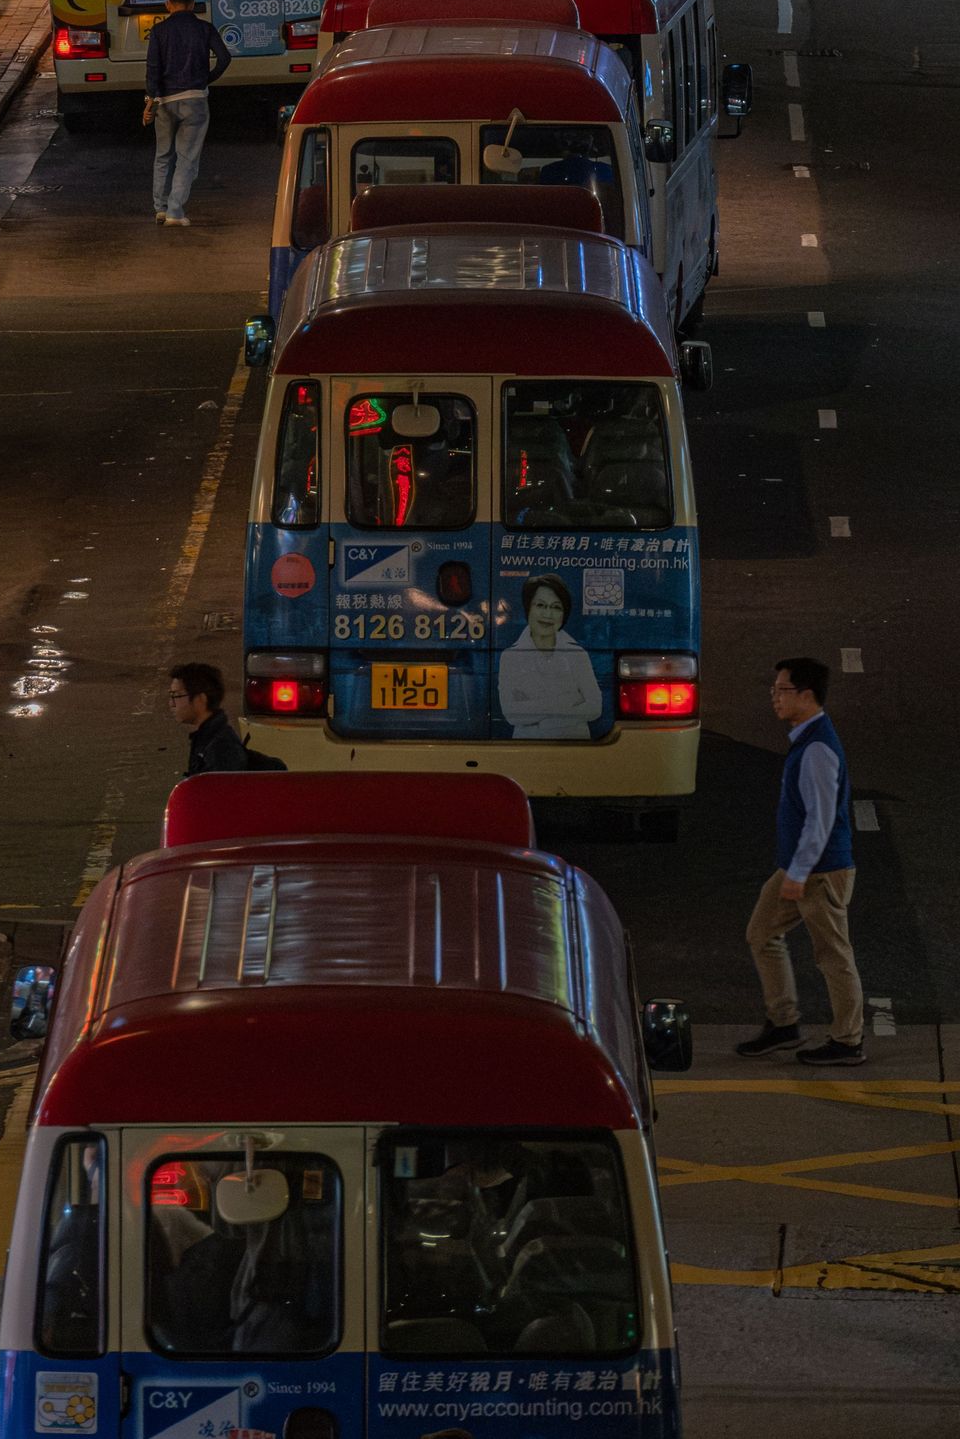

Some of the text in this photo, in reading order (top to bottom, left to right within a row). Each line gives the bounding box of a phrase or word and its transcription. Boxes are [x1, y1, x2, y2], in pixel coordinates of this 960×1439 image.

[240, 0, 280, 16] 2338
[347, 541, 473, 561] C&Y Since 1994
[500, 555, 690, 572] www.cnyaccounting.com.hk
[334, 614, 486, 640] 8126 8126
[393, 668, 427, 687] MJ
[380, 688, 438, 707] 1120
[149, 1381, 336, 1409] C&Y Since 1994
[377, 1397, 664, 1421] www.cnyaccounting.com.hk
